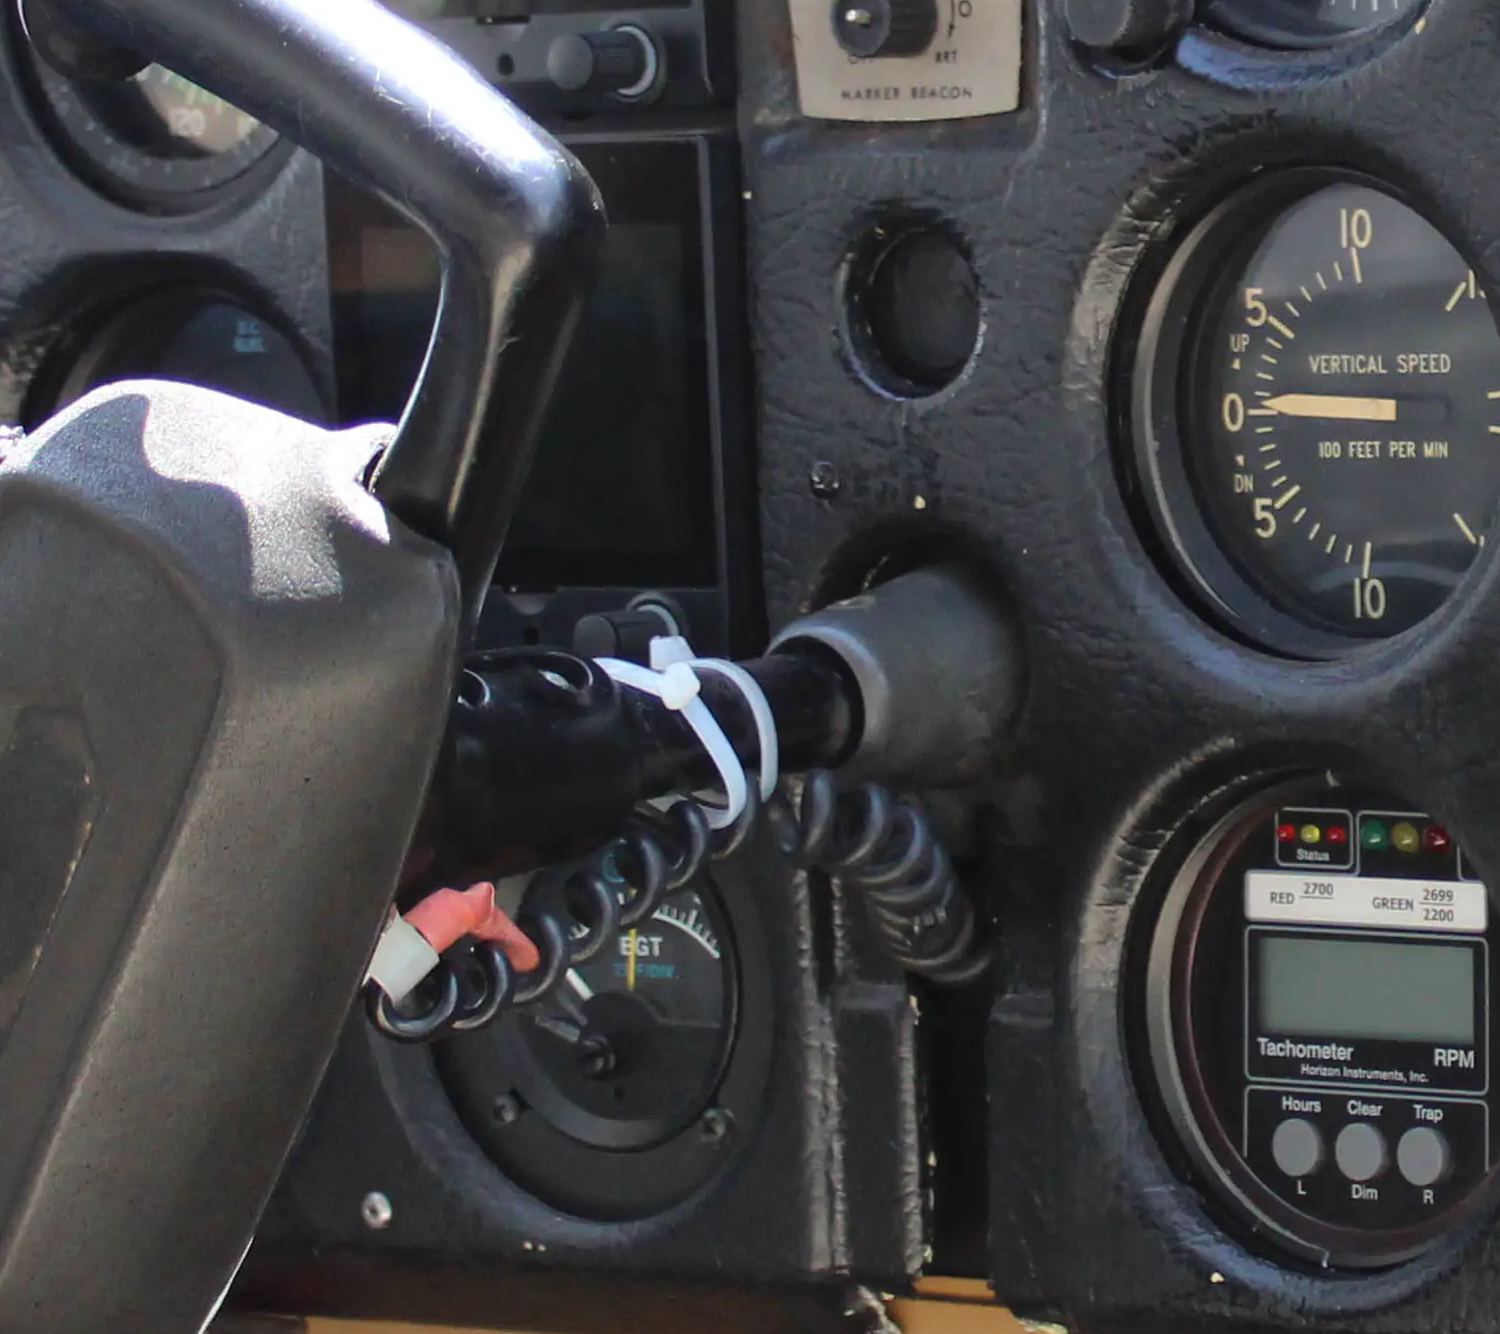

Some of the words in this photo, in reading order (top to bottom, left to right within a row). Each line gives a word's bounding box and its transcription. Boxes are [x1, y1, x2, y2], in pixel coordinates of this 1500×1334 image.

[1340, 208, 1372, 248] 10
[1244, 287, 1268, 327] 5
[1308, 354, 1388, 374] VERTICAL
[1396, 354, 1451, 373] SPEED
[1222, 393, 1245, 432] 0
[1348, 442, 1381, 459] FEET
[1388, 442, 1416, 459] PER
[1424, 442, 1449, 459] MIN
[1254, 498, 1277, 539] 5
[1354, 577, 1387, 619] 10
[1269, 891, 1295, 906] RED
[1302, 882, 1334, 897] 2700
[1372, 896, 1415, 911] GREEN
[1423, 909, 1454, 923] 2200
[619, 935, 663, 957] EGT
[1257, 1038, 1353, 1061] Tachometer
[1434, 1048, 1475, 1069] RPM
[1282, 1096, 1322, 1114] Hours
[1347, 1100, 1382, 1117] Clear
[1412, 1105, 1444, 1123] Trap
[1351, 1184, 1379, 1201] Dim
